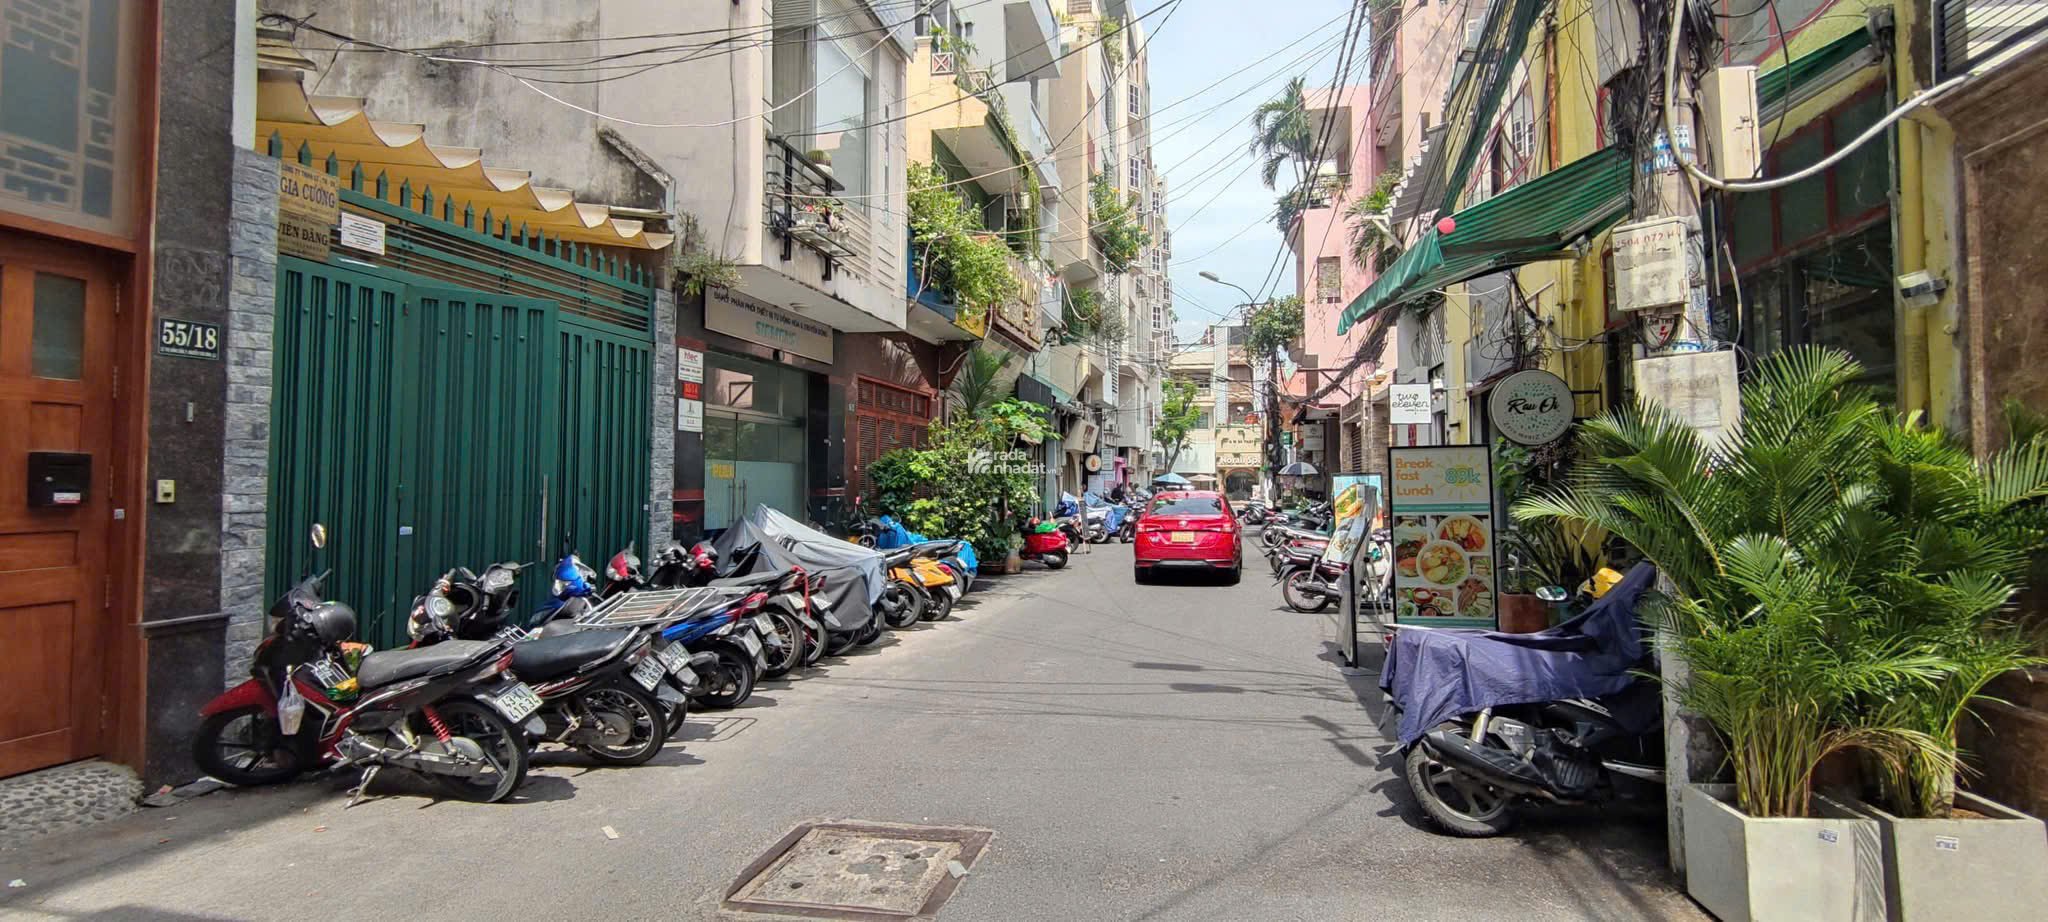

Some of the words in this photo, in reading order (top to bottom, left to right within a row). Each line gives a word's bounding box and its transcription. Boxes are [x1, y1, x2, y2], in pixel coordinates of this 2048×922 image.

[280, 176, 299, 197] GIA
[162, 321, 217, 350] 55/18
[1507, 398, 1537, 414] Rau
[1395, 457, 1433, 469] Break
[1395, 470, 1420, 481] fast
[1445, 468, 1481, 484] 89k
[1396, 484, 1433, 496] Lunch
[508, 693, 541, 720] 416.34
